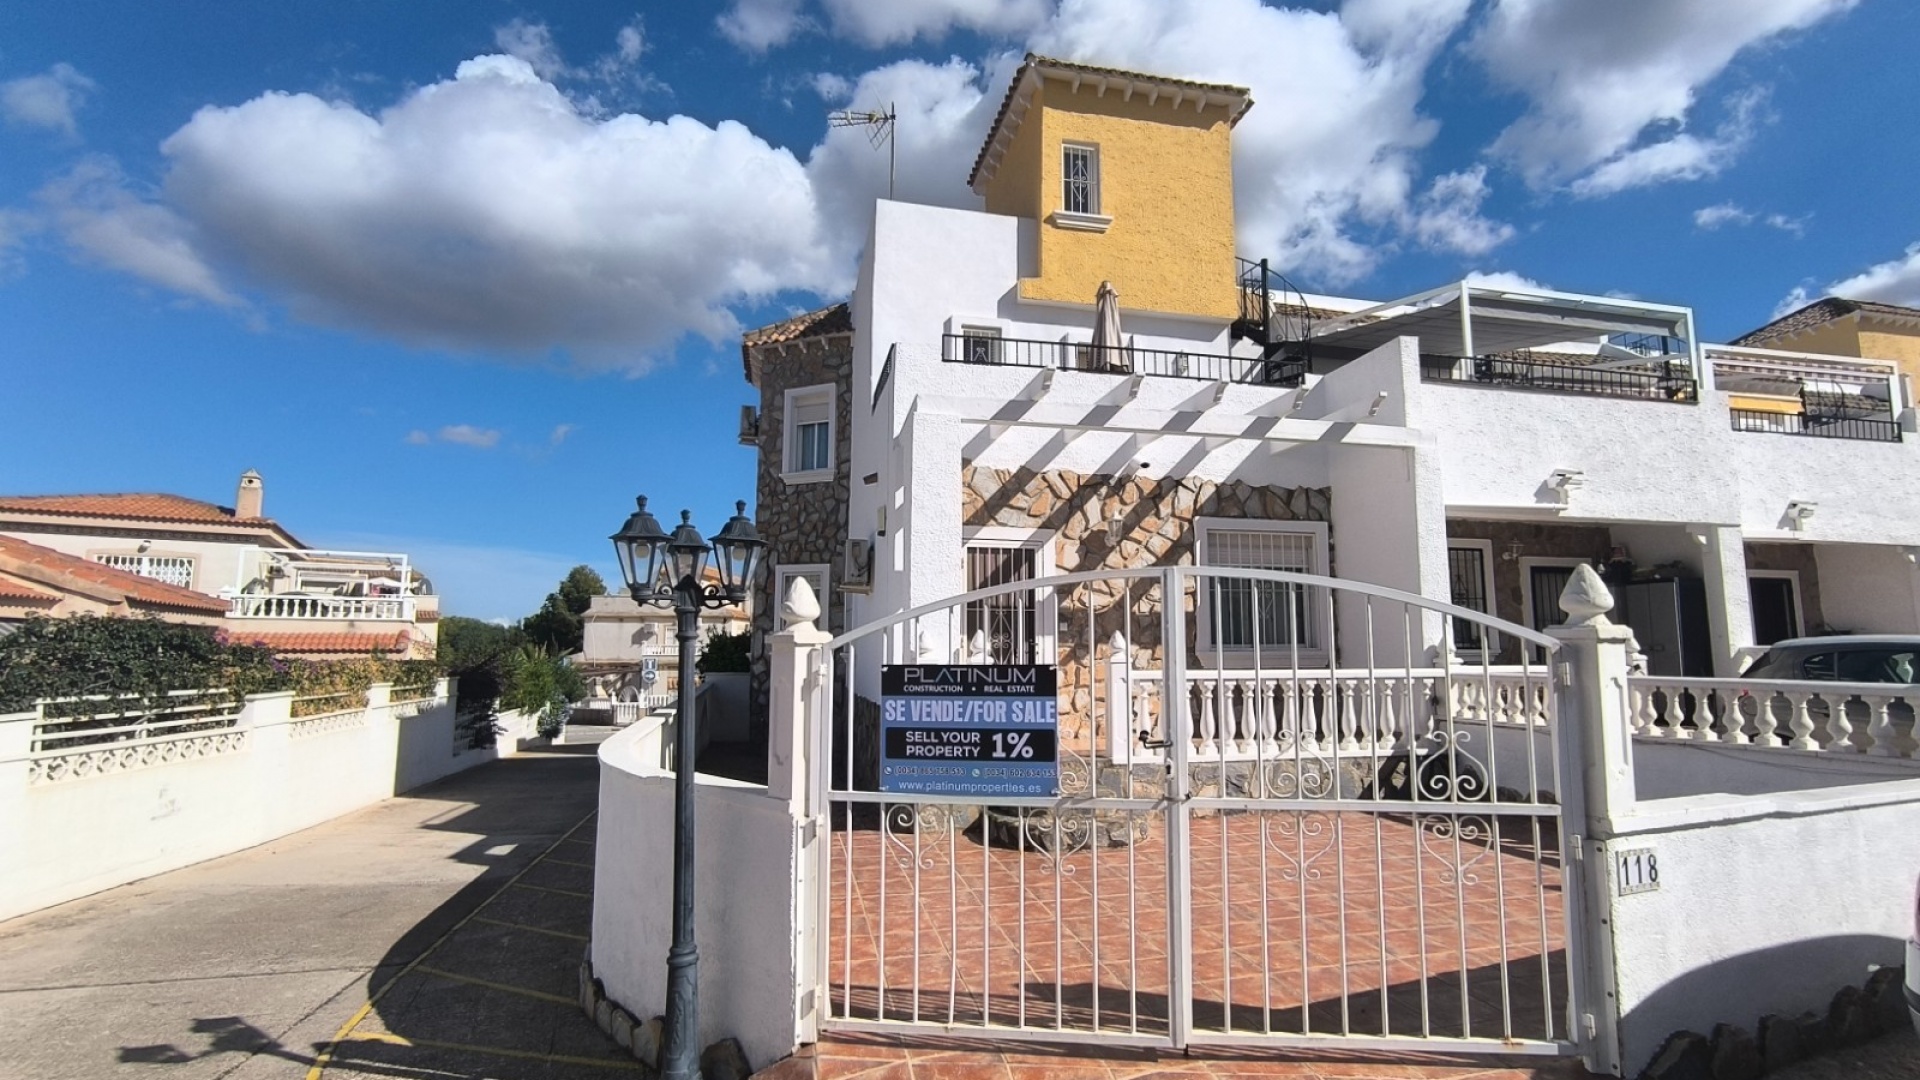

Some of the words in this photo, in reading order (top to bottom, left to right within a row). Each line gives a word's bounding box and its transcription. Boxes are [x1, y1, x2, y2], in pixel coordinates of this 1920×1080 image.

[904, 668, 1036, 683] PLATINUM
[903, 685, 963, 693] CONSTRUCTION
[984, 685, 1004, 693] REAL
[1007, 685, 1035, 693] ESTATE
[885, 699, 906, 722] SE
[910, 700, 1007, 722] VENDE/FOR
[1012, 700, 1056, 723] SALE
[905, 731, 939, 743] SELL
[941, 732, 981, 744] YOUR
[906, 745, 981, 757] PROPERTY
[991, 732, 1034, 759] 1%
[898, 780, 1042, 793] www.platinumproperties.es
[1621, 853, 1658, 885] 118
